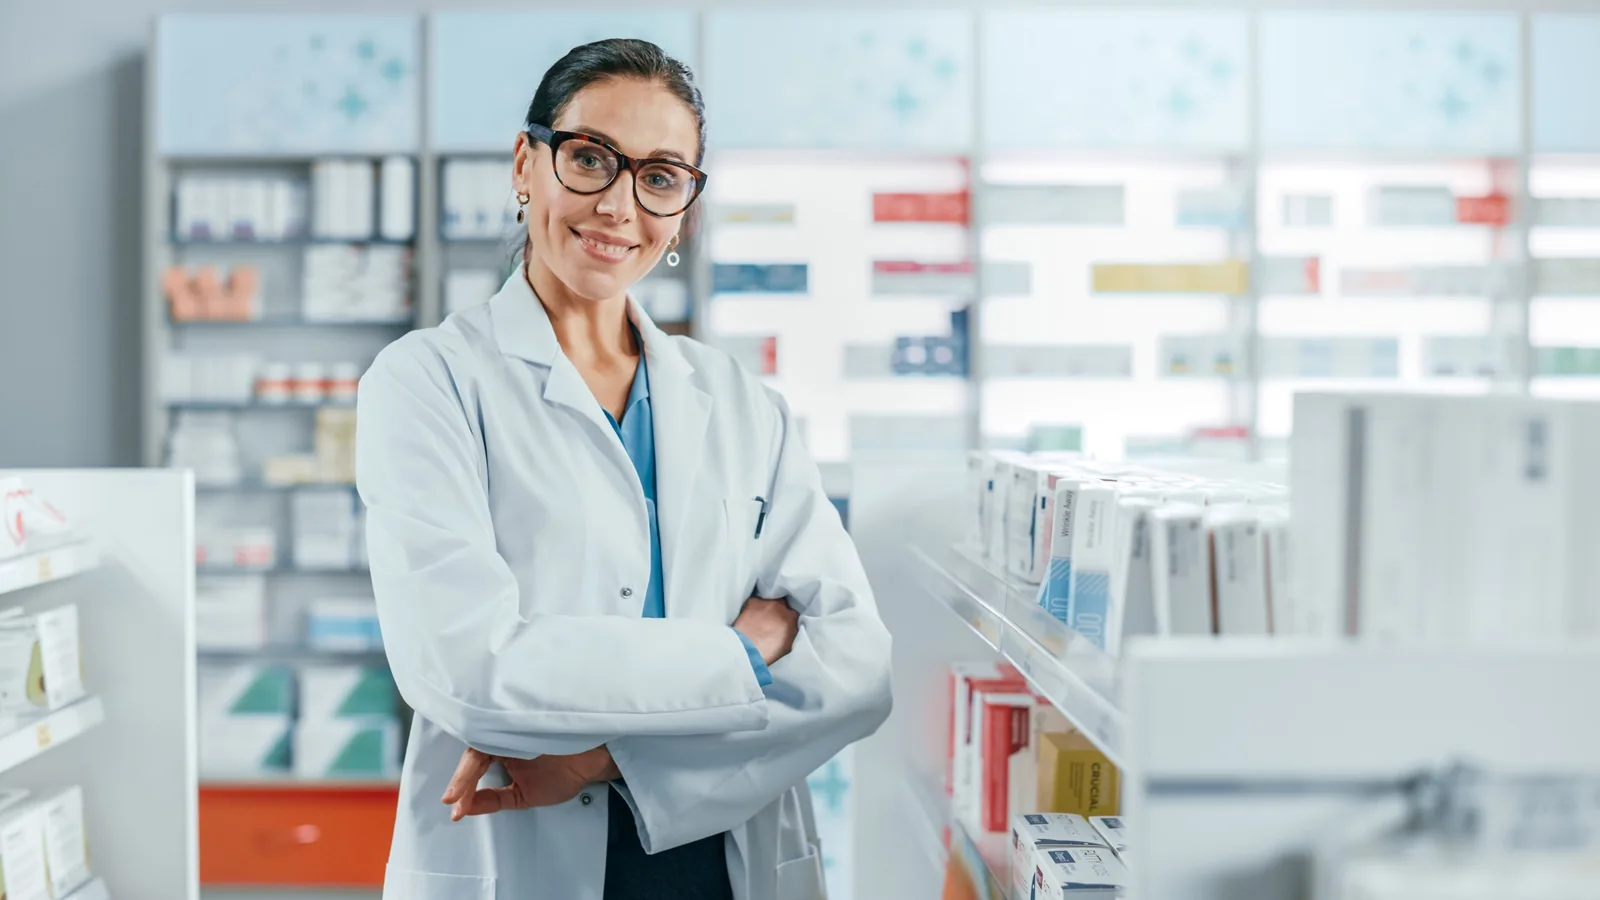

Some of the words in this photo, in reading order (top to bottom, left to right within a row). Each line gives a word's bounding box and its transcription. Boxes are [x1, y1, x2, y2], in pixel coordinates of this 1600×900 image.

[1063, 490, 1075, 509] Away
[1061, 510, 1071, 537] Wrinkle
[1089, 762, 1101, 812] CRUCIAL
